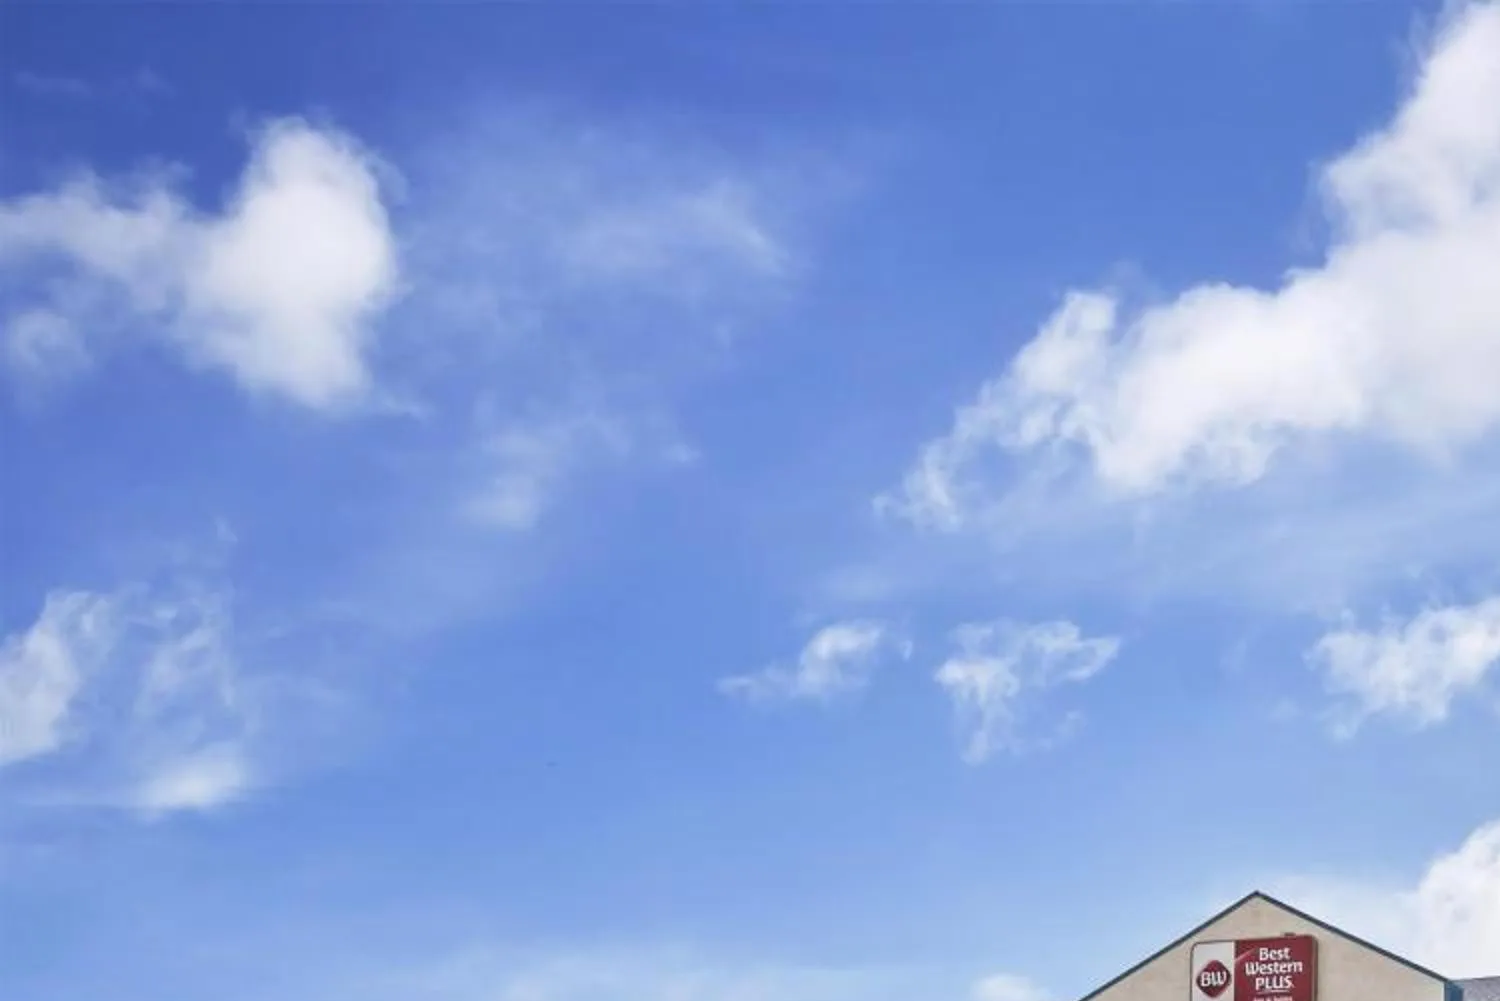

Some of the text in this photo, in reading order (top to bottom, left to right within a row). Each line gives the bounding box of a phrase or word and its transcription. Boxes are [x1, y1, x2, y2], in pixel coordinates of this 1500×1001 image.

[1259, 947, 1290, 961] Best
[1245, 961, 1303, 975] Western
[1201, 971, 1227, 987] BW
[1255, 976, 1292, 990] PLUS
